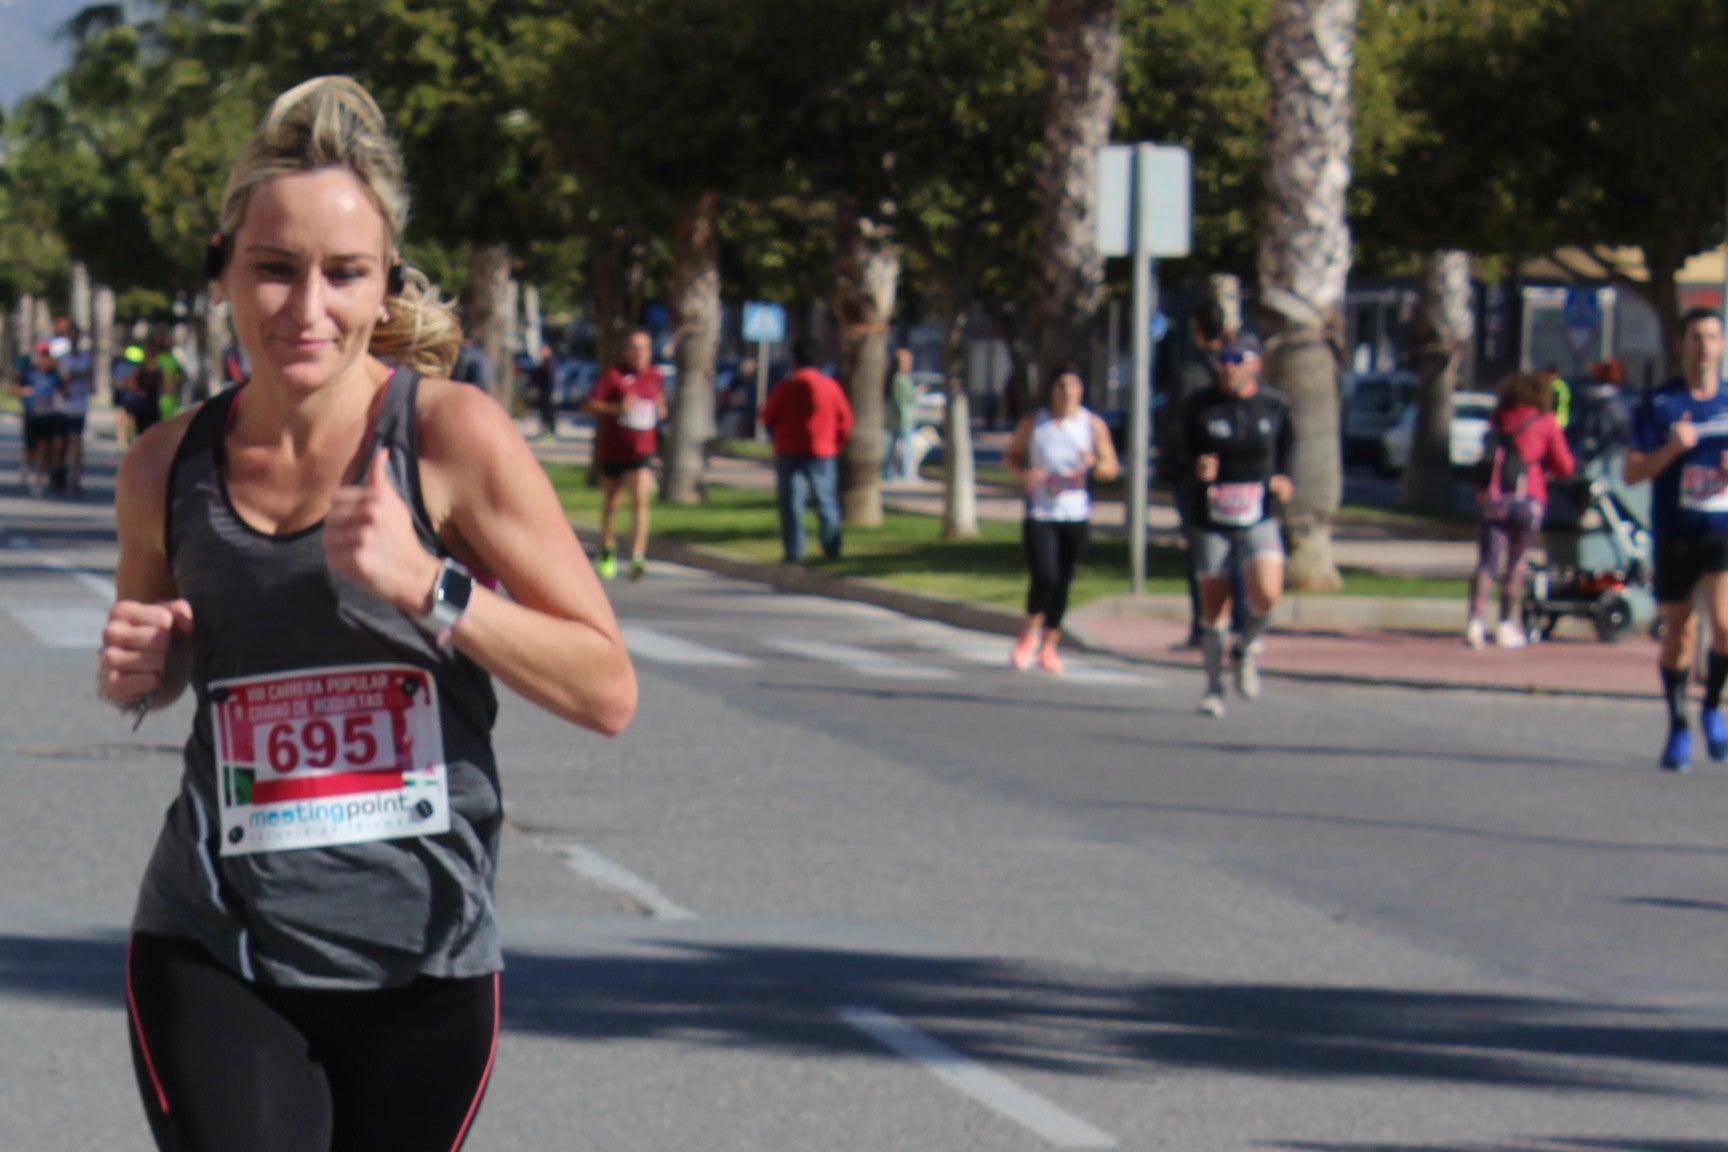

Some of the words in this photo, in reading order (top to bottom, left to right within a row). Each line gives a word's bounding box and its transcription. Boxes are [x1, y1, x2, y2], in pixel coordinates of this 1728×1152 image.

[267, 679, 324, 701] CARRERA
[325, 673, 389, 694] POPULAR
[267, 715, 378, 774] 695
[249, 793, 410, 827] meetingpoint
